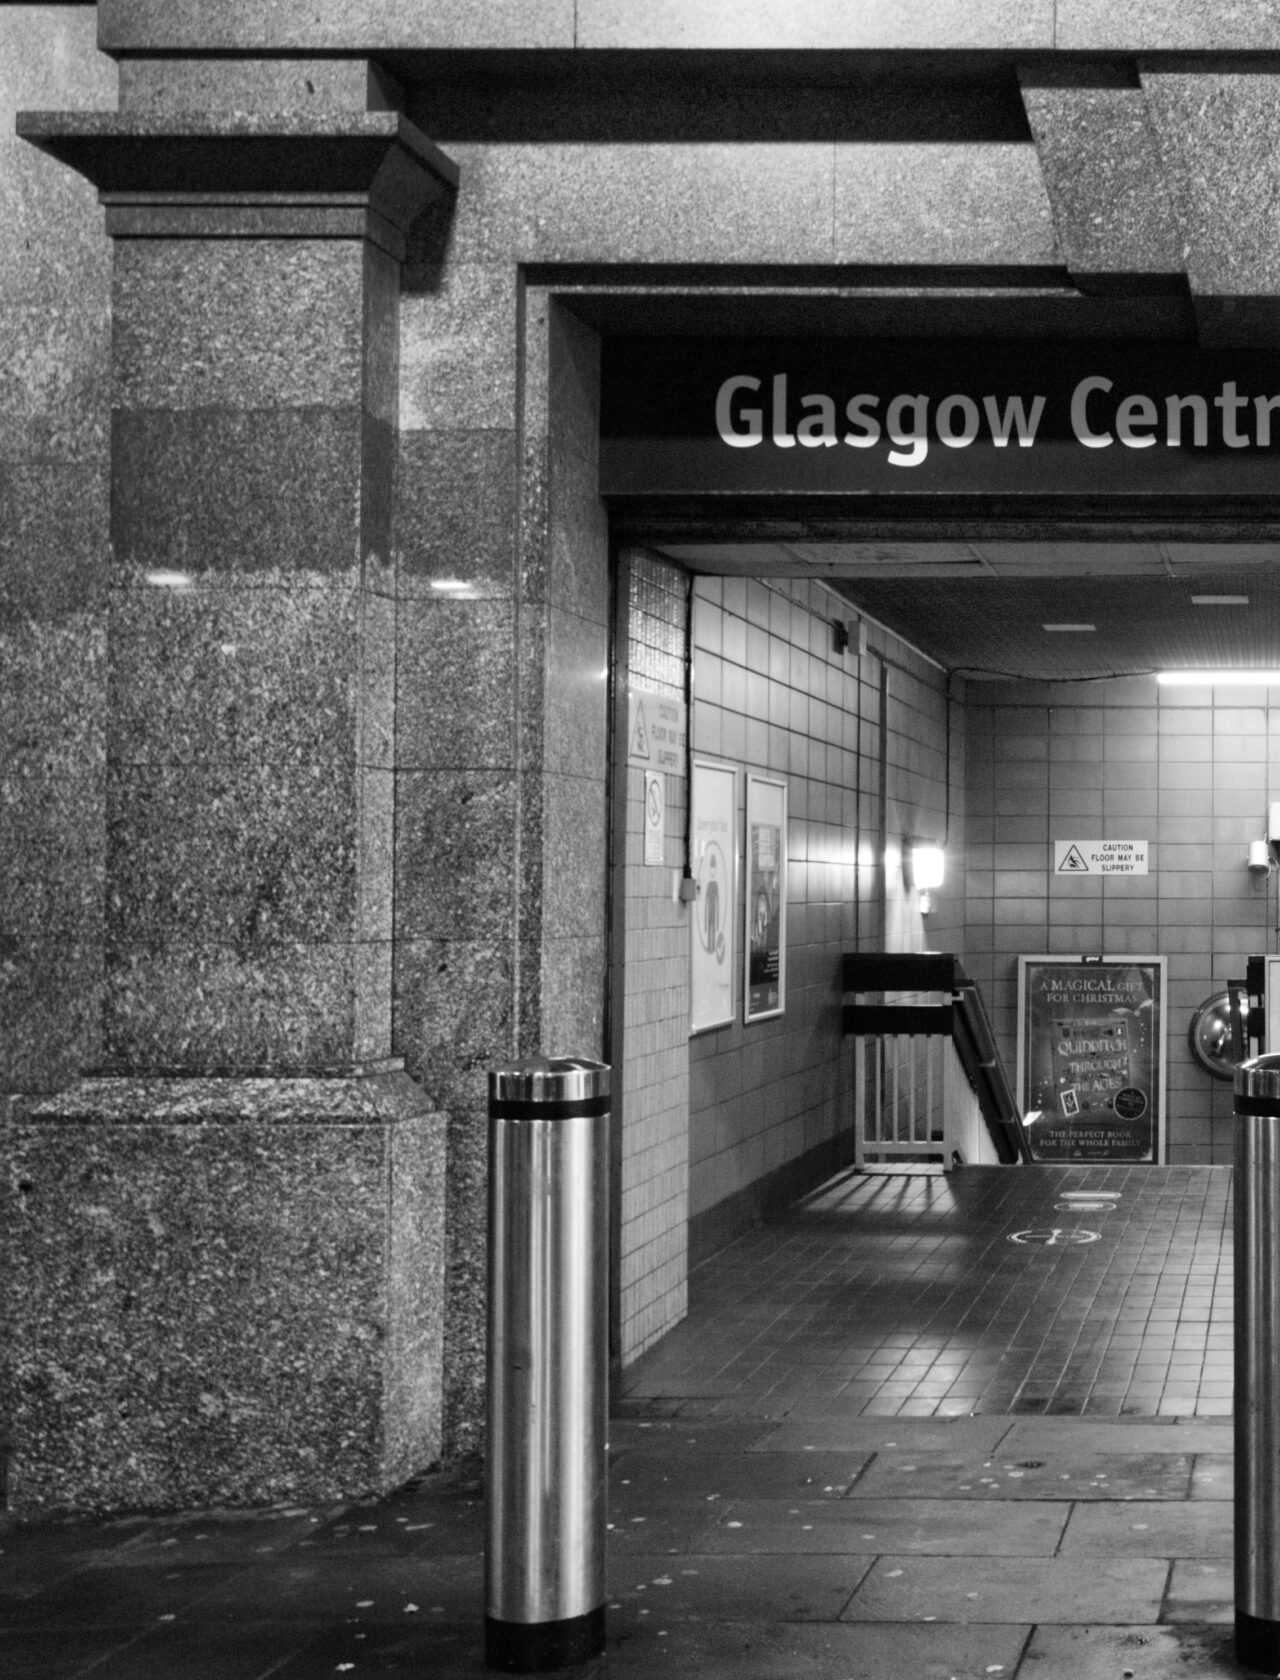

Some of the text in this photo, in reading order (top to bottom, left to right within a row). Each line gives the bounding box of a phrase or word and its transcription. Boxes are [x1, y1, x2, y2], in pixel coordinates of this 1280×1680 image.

[715, 374, 1047, 467] Glasgow
[1040, 979, 1143, 991] A MAGICAL GIFT
[1046, 993, 1137, 1003] FOR CHRISTMAS
[1057, 1038, 1127, 1057] QUIDDITCH
[1068, 1058, 1121, 1073] THROUGH
[1071, 1082, 1090, 1093] THE
[1048, 1131, 1067, 1139] THE
[1068, 1131, 1106, 1139] PERFECT
[1040, 1139, 1057, 1147] FOR
[1060, 1139, 1076, 1147] THE
[1078, 1139, 1109, 1147] WHOLE
